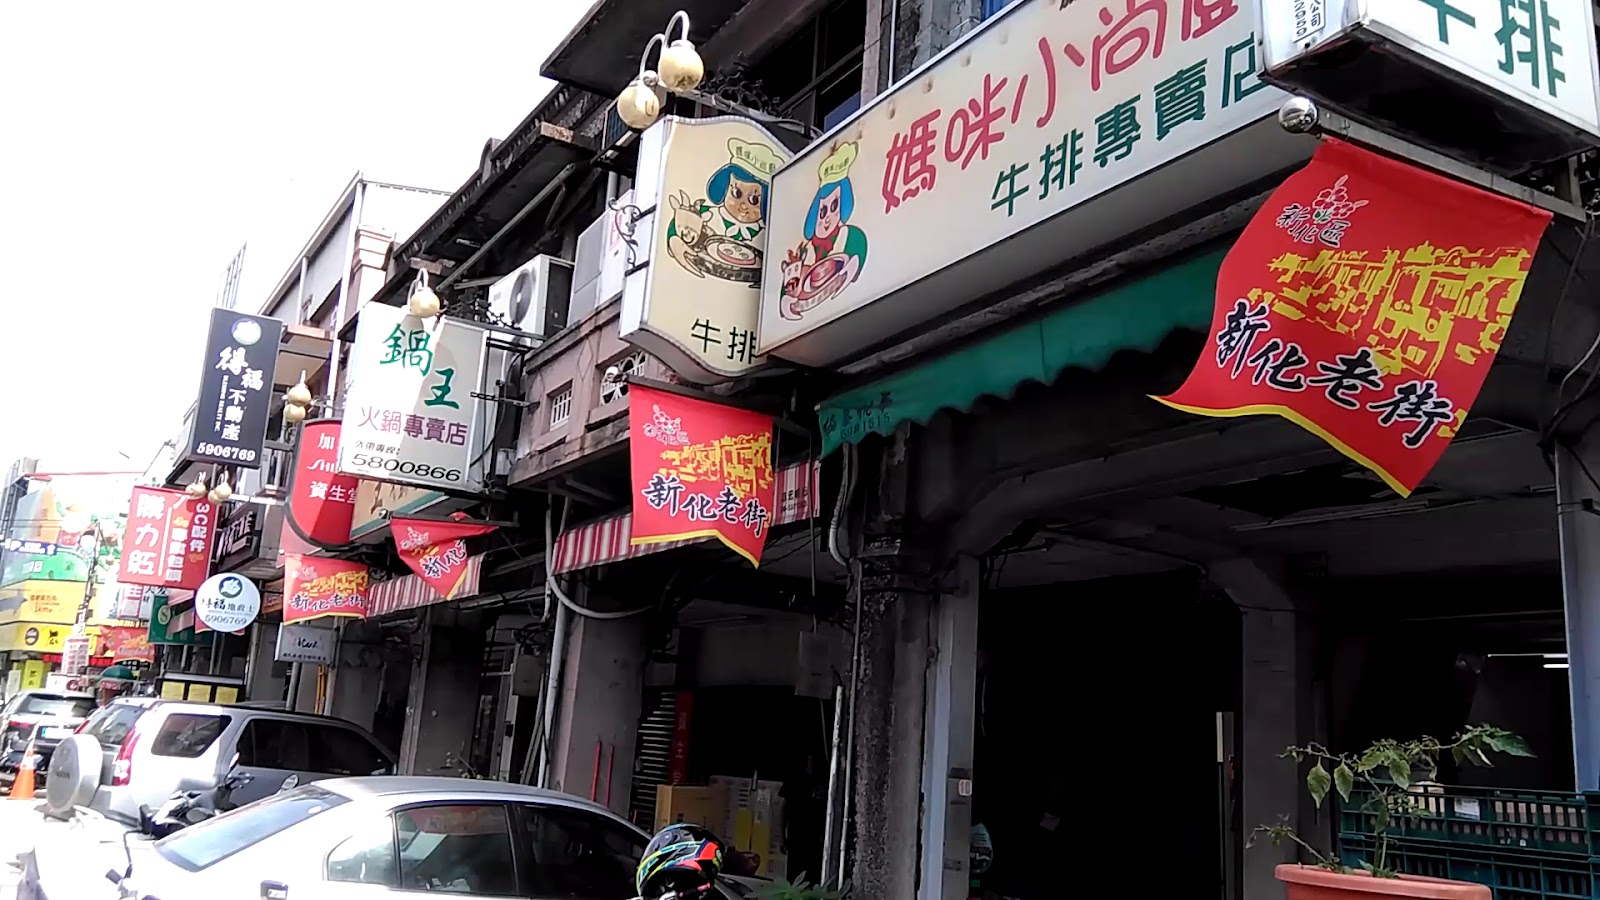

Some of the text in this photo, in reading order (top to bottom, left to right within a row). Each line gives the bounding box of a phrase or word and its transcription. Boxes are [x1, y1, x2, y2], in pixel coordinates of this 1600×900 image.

[991, 31, 1271, 217] 牛排專賣店
[380, 323, 460, 410] 鍋王
[691, 319, 759, 364] 牛排
[1216, 299, 1456, 449] 新化老街
[196, 442, 256, 462] 5906769
[357, 405, 468, 447] 火鍋專賣店
[351, 453, 462, 482] 5800866
[642, 475, 769, 538] 新化老街
